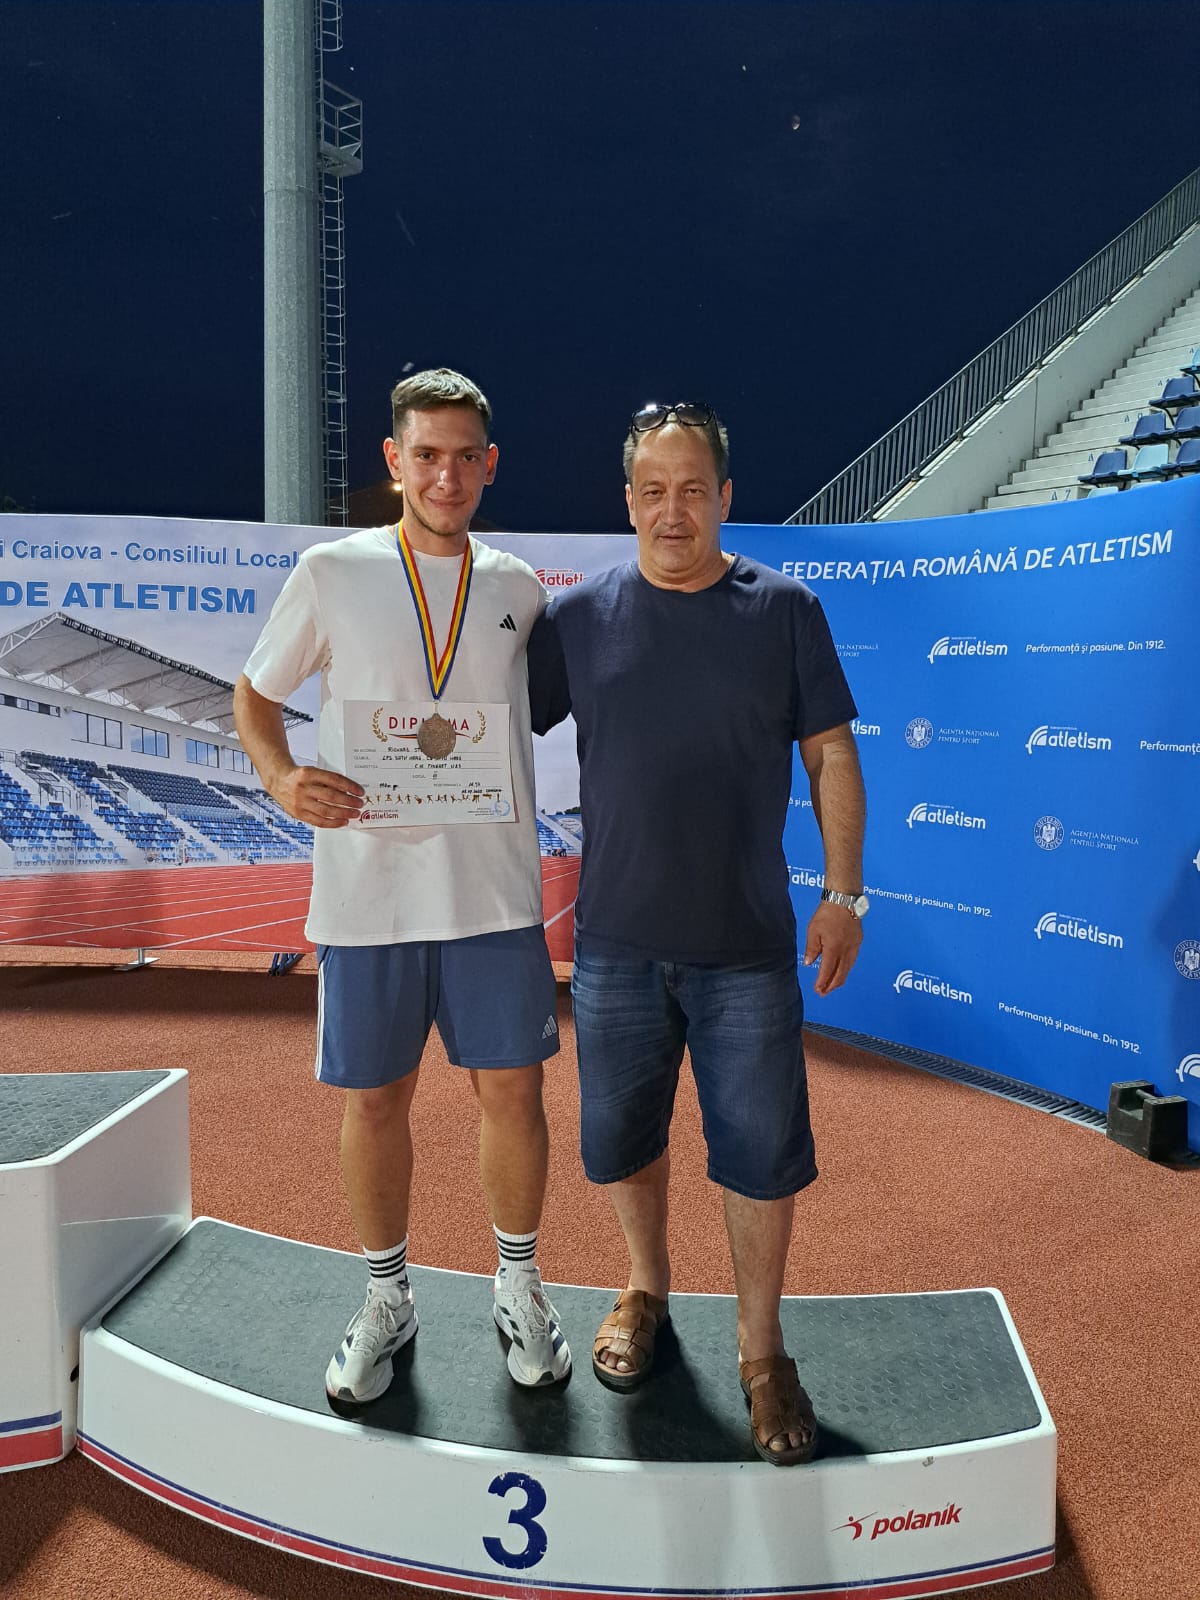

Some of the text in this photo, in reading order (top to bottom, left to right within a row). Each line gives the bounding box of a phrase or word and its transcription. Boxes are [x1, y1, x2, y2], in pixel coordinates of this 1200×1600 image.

[12, 540, 102, 560] Craiova
[125, 542, 227, 565] Consiliul
[236, 548, 298, 569] Local
[781, 529, 1173, 585] FEDERAȚIA ROMÂNĂ DE ATLETISM
[547, 572, 583, 586] atleti
[62, 582, 256, 614] ATLETISM
[949, 640, 1008, 656] atletism
[1025, 642, 1080, 654] Performanță
[1089, 642, 1126, 654] pasiune.
[1128, 640, 1143, 651] Din
[1146, 639, 1166, 650] 1912.
[1048, 731, 1112, 750] atletism
[927, 809, 986, 829] atletism
[791, 873, 826, 889] atleti
[863, 886, 913, 903] Performanță
[922, 898, 956, 911] pasiune.
[957, 903, 971, 913] Din
[973, 906, 992, 917] 1912.
[1057, 920, 1123, 949] atletism
[914, 977, 973, 1004] atletism
[998, 1002, 1053, 1026] Performanță
[1063, 1022, 1101, 1041] pasiune.
[1102, 1034, 1118, 1047] Din
[1120, 1039, 1142, 1055] 1912.
[482, 1471, 548, 1570] 3
[870, 1503, 963, 1541] polanik
